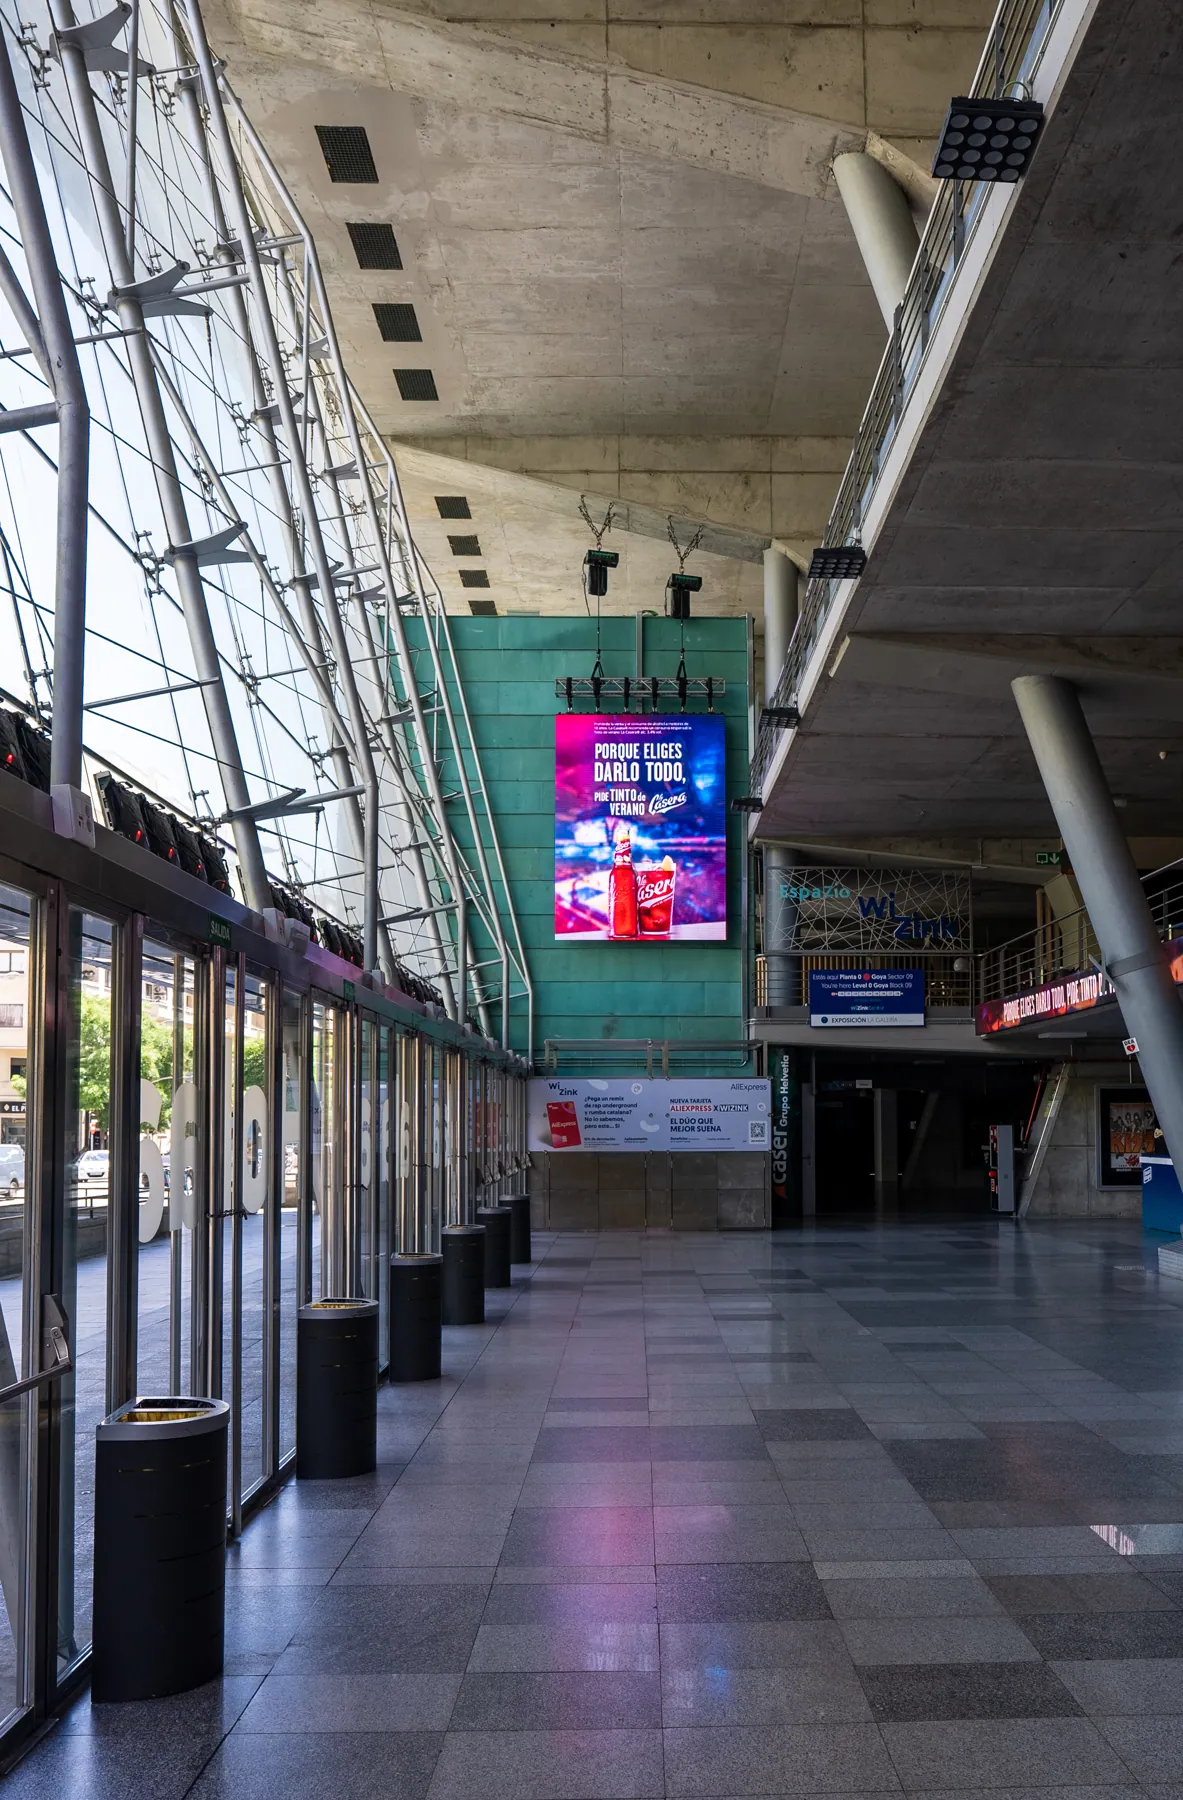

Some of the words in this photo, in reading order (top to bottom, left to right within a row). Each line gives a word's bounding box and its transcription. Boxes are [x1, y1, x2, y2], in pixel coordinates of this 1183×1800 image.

[595, 743, 640, 762] PORQUE
[644, 743, 682, 759] ELIGES
[595, 762, 639, 782] DARLO
[645, 762, 686, 784] TODO,
[594, 792, 609, 802] PIDE
[610, 789, 636, 802] TINTO
[637, 792, 646, 802] de
[648, 791, 687, 815] Casera
[610, 802, 644, 816] VERANO
[210, 920, 230, 940] SALIDA
[780, 1055, 790, 1094] Helvetia
[731, 1083, 767, 1092] AliExpress
[779, 1096, 790, 1127] Grupo
[772, 1127, 788, 1184] caser
